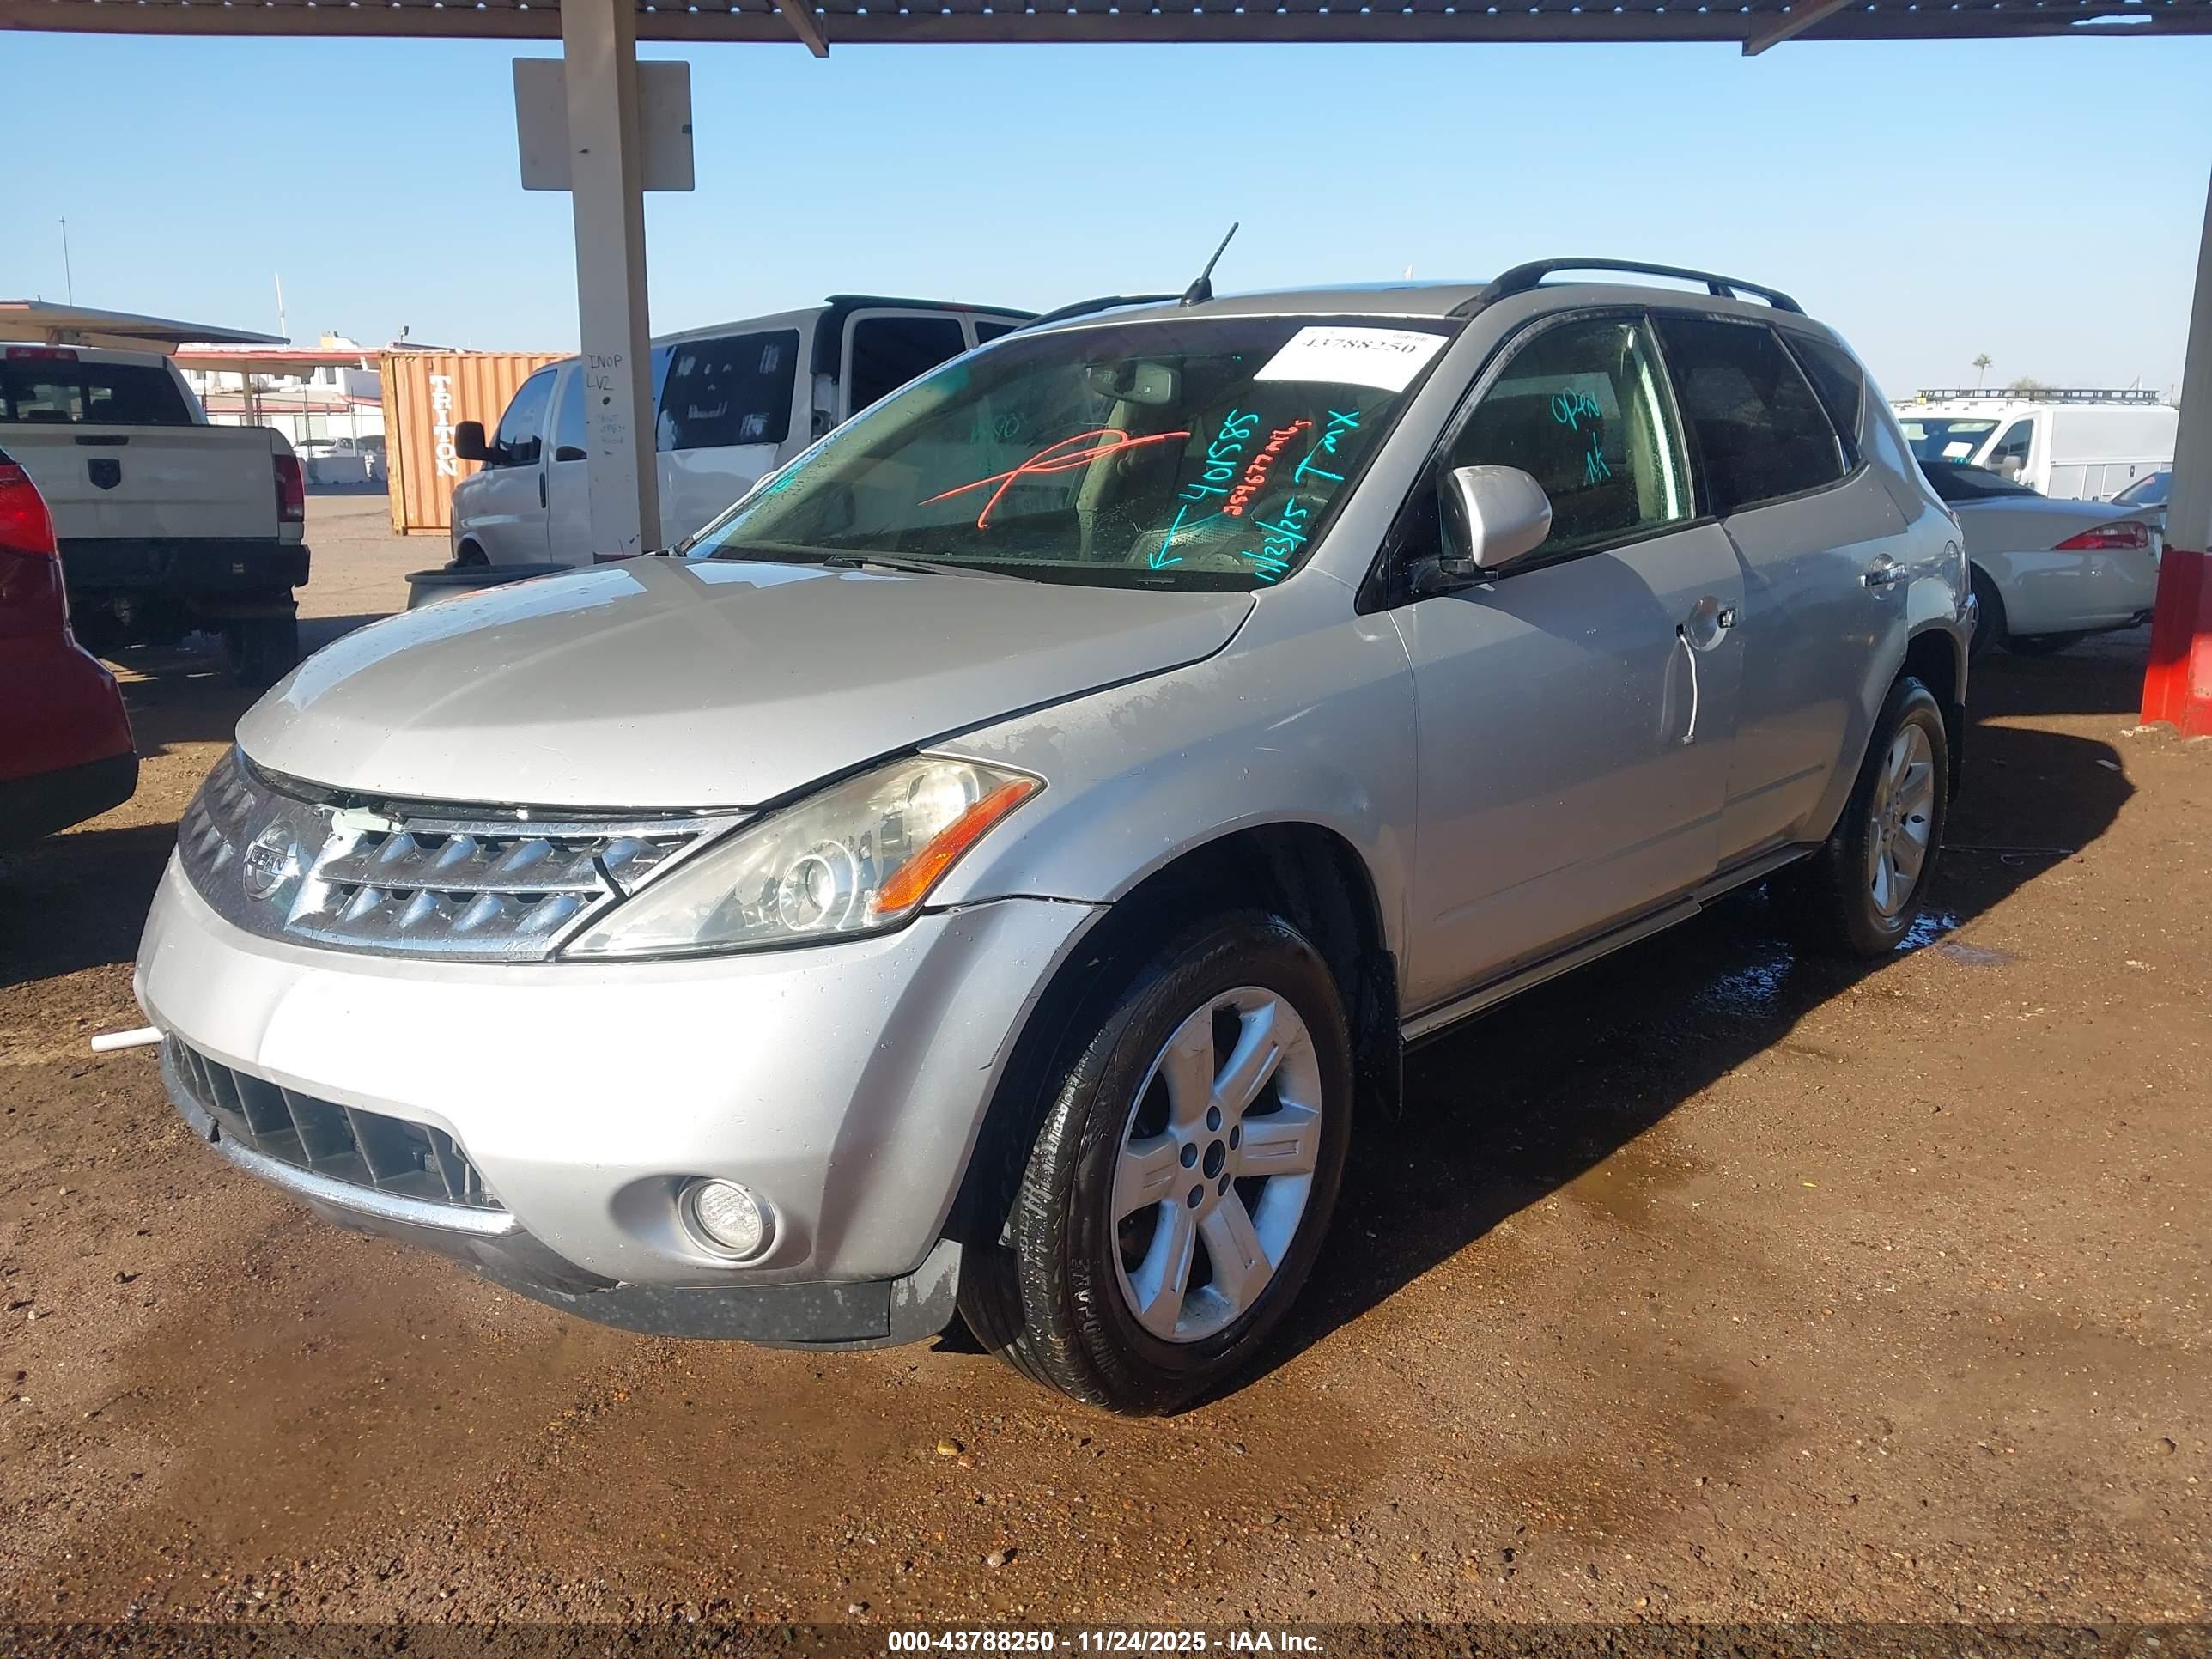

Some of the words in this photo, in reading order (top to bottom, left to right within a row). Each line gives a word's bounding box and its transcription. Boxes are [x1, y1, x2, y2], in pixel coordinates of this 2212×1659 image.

[587, 354, 623, 369] INOP
[428, 374, 459, 477] TRITON
[1178, 408, 1260, 501] 401585
